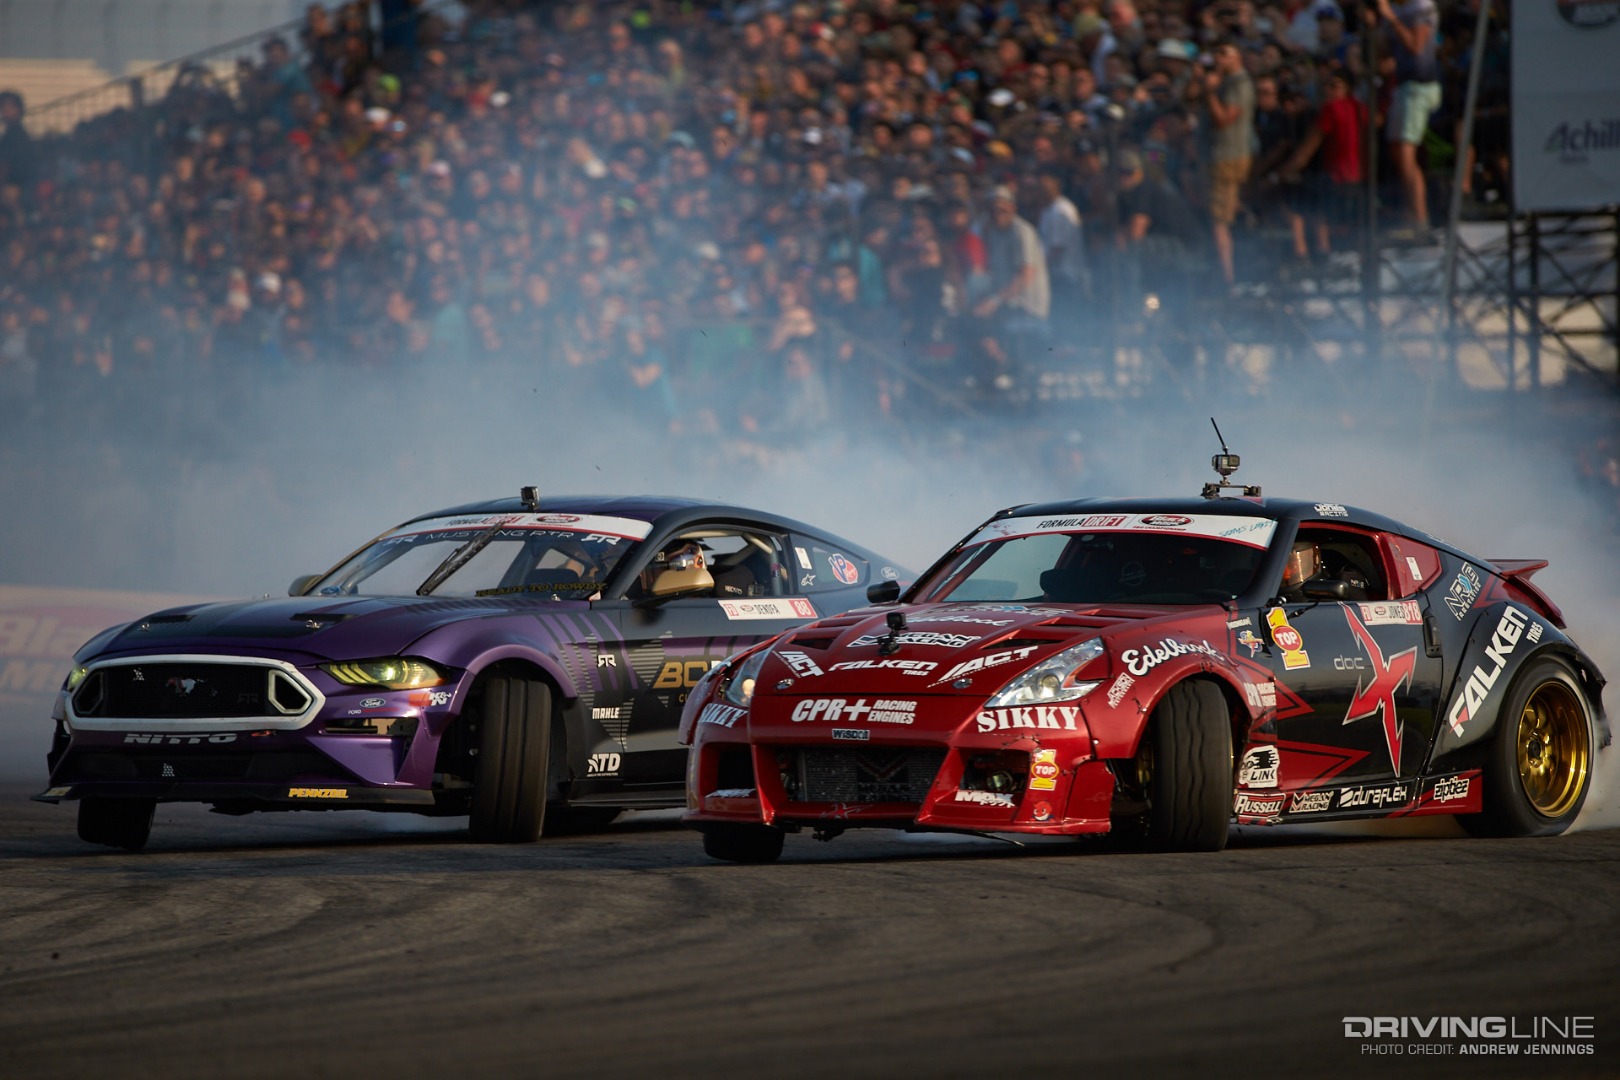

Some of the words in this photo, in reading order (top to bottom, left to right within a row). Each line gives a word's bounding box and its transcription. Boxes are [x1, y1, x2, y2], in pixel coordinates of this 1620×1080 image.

[1036, 517, 1086, 529] FORMULA
[1084, 515, 1126, 527] DRIFT
[425, 530, 525, 541] MUSTNG
[529, 530, 574, 540] RTR
[475, 584, 525, 597] READY
[528, 583, 550, 592] TO
[551, 582, 607, 593] ROWDY
[793, 600, 811, 616] 88
[1401, 602, 1422, 622] 818
[1275, 631, 1298, 646] TOP
[1526, 621, 1544, 644] TIRES
[828, 659, 939, 671] FALKEN
[1449, 605, 1528, 738] FALKEN
[873, 699, 918, 713] RACING
[592, 707, 620, 720] MAHLE
[867, 711, 916, 725] ENGINES
[976, 706, 1080, 733] SIKKY
[123, 733, 238, 744] NITTO
[1035, 765, 1057, 776] TOP
[288, 787, 349, 799] PENNZOIL
